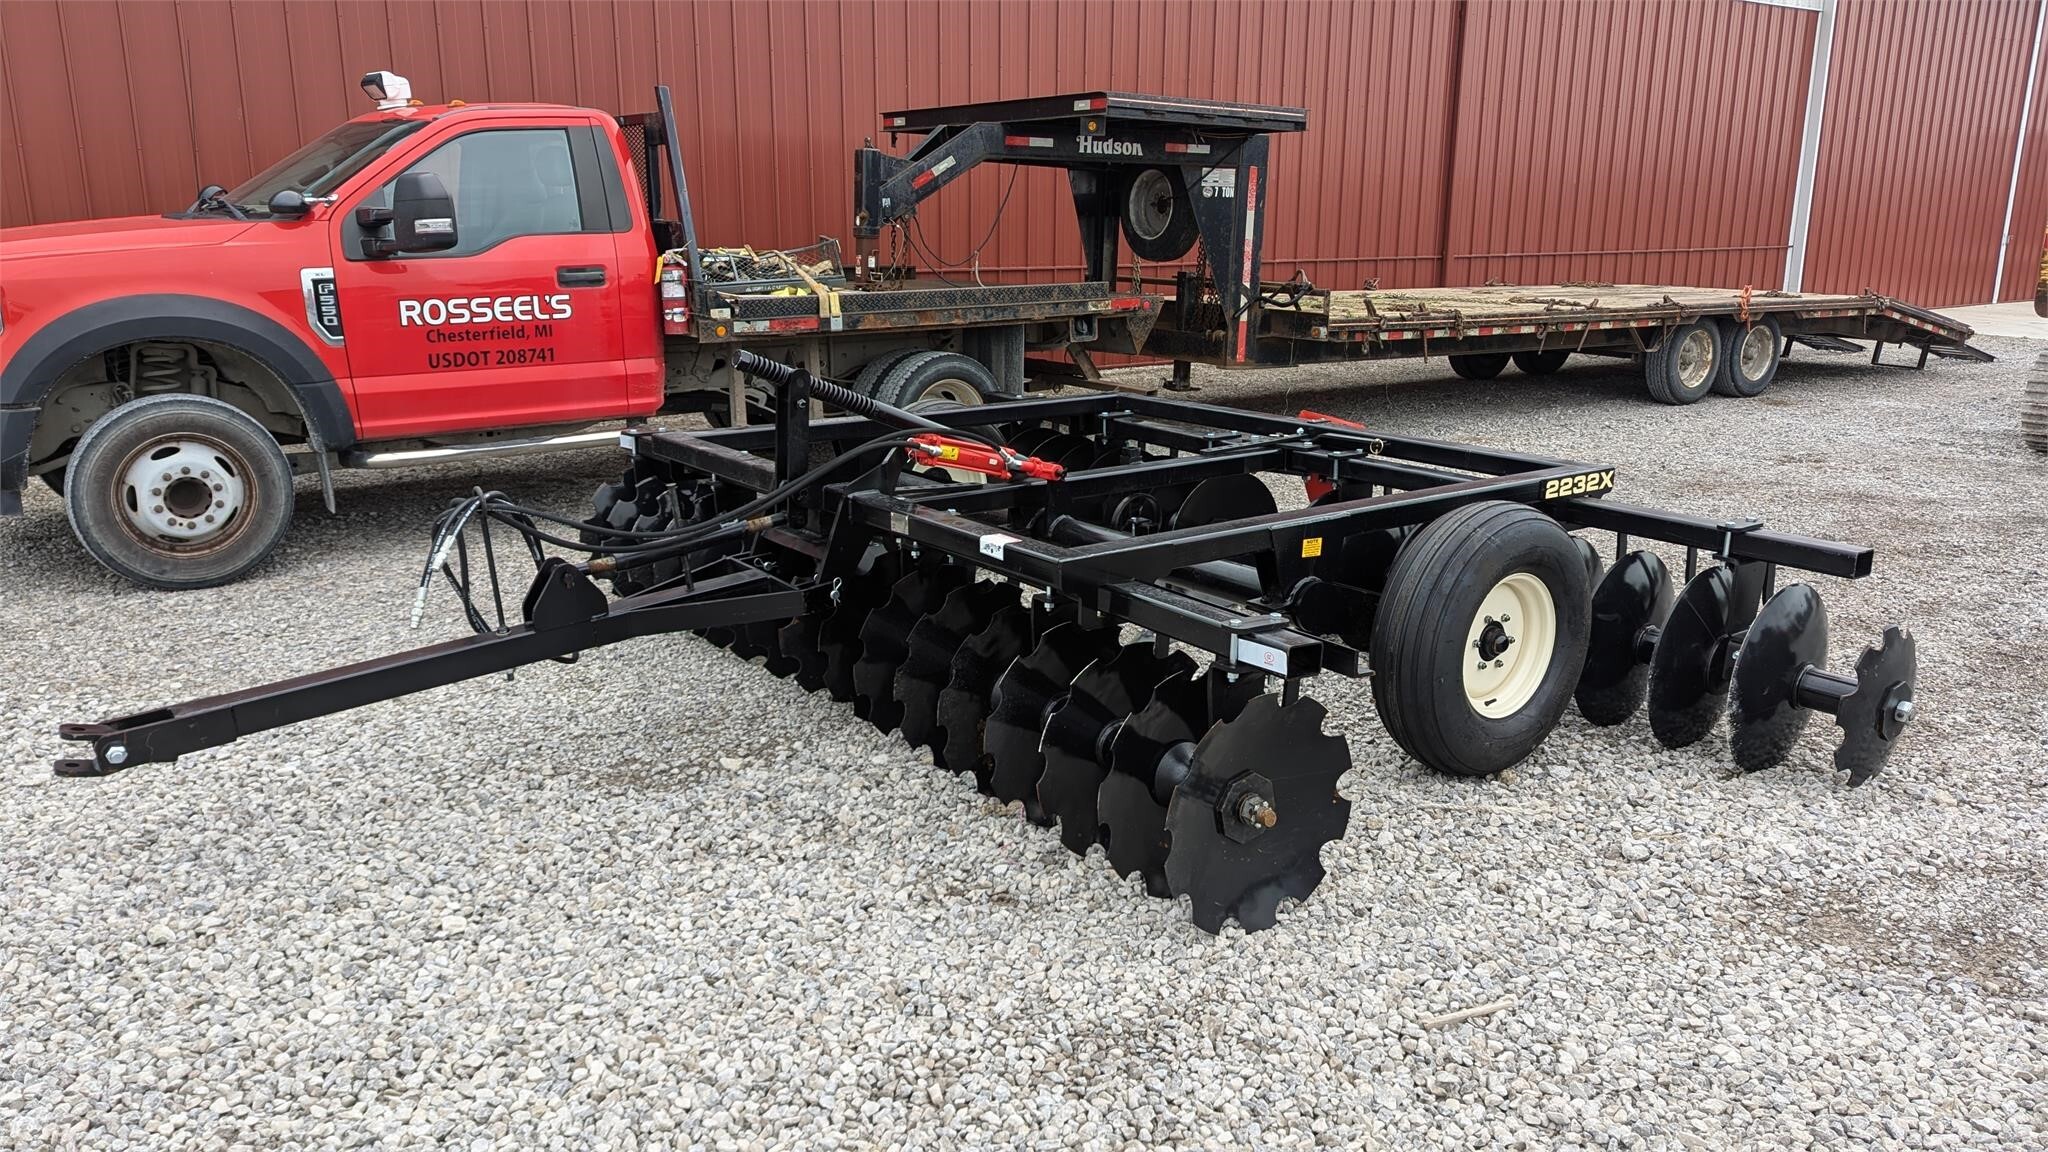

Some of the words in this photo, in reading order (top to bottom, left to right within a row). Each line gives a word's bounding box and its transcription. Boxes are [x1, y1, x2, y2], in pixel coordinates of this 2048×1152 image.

[1076, 135, 1143, 156] Hudson
[1214, 186, 1219, 198] 7
[1222, 186, 1235, 198] TON
[399, 294, 572, 327] ROSSEEL'S
[426, 326, 530, 343] Chesterfield,
[535, 324, 553, 338] MI
[428, 351, 490, 369] USDOT
[496, 347, 555, 365] 208741
[1545, 470, 1615, 499] 2232X
